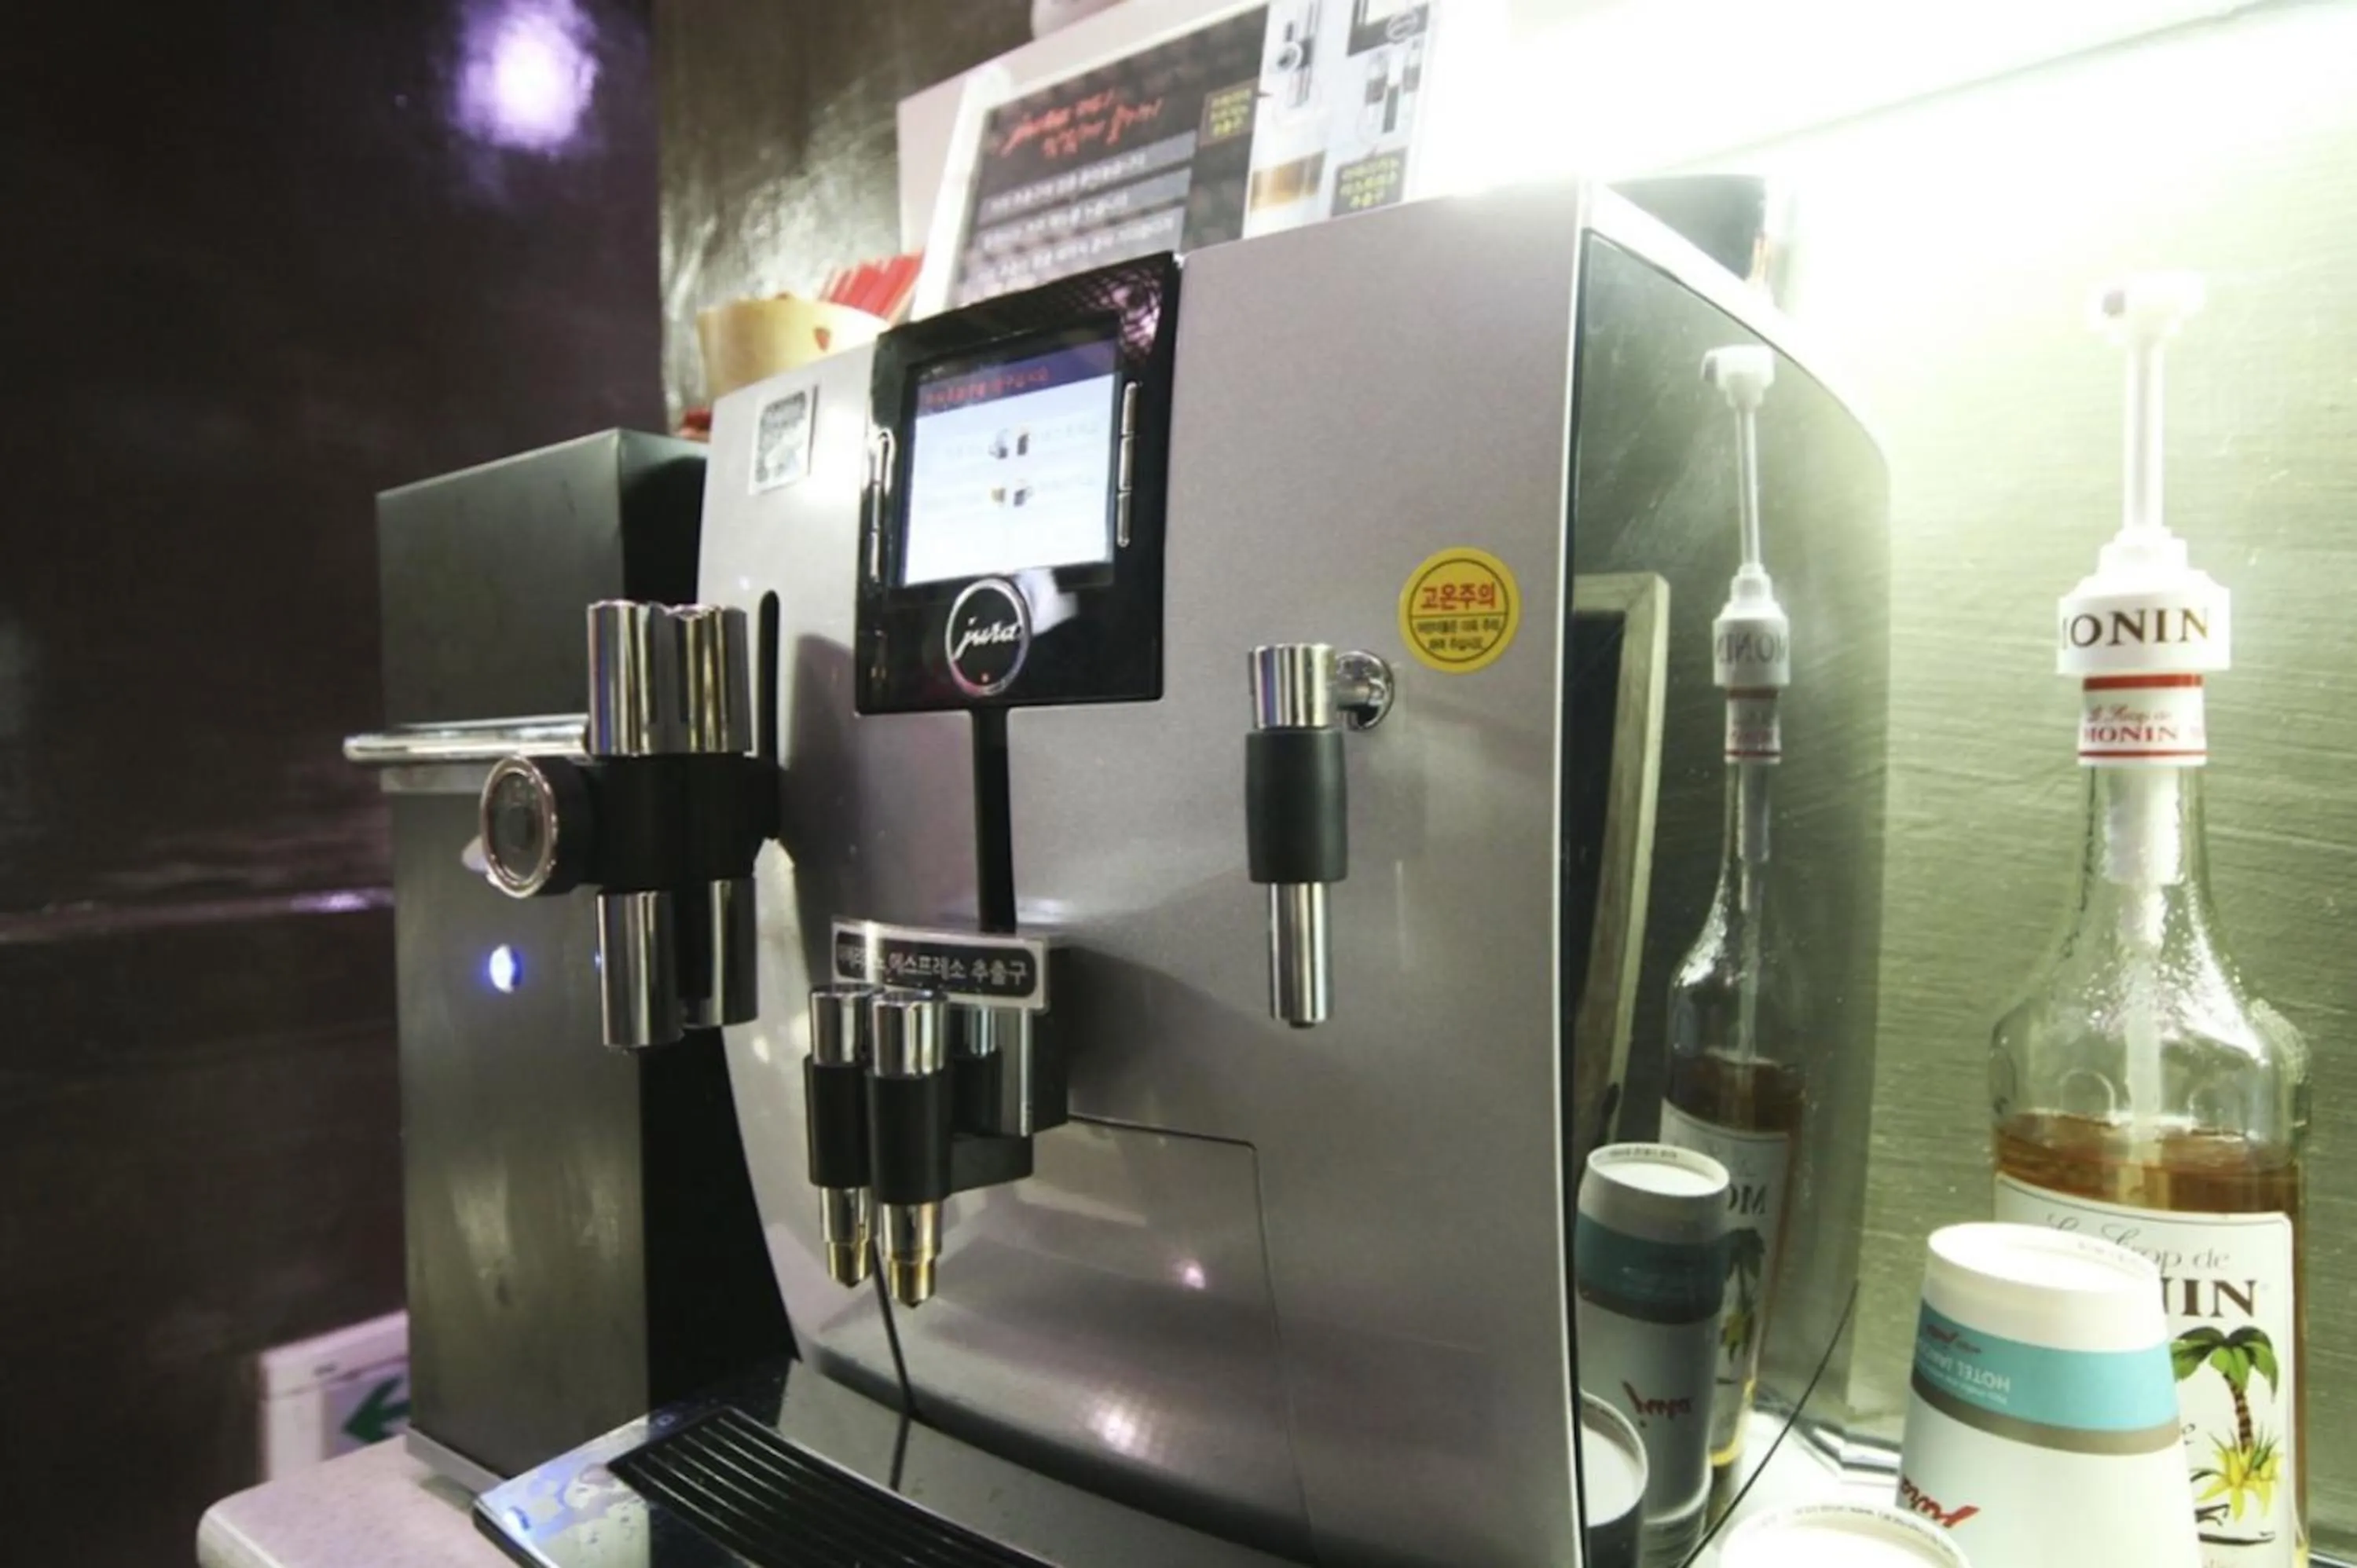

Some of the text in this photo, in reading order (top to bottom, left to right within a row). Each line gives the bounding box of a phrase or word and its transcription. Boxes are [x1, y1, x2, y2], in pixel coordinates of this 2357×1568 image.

[1420, 581, 1496, 610] 고온주의
[2061, 607, 2210, 651] ONIN
[970, 958, 1028, 986] 추출구
[1956, 1359, 2011, 1394] HOTEL
